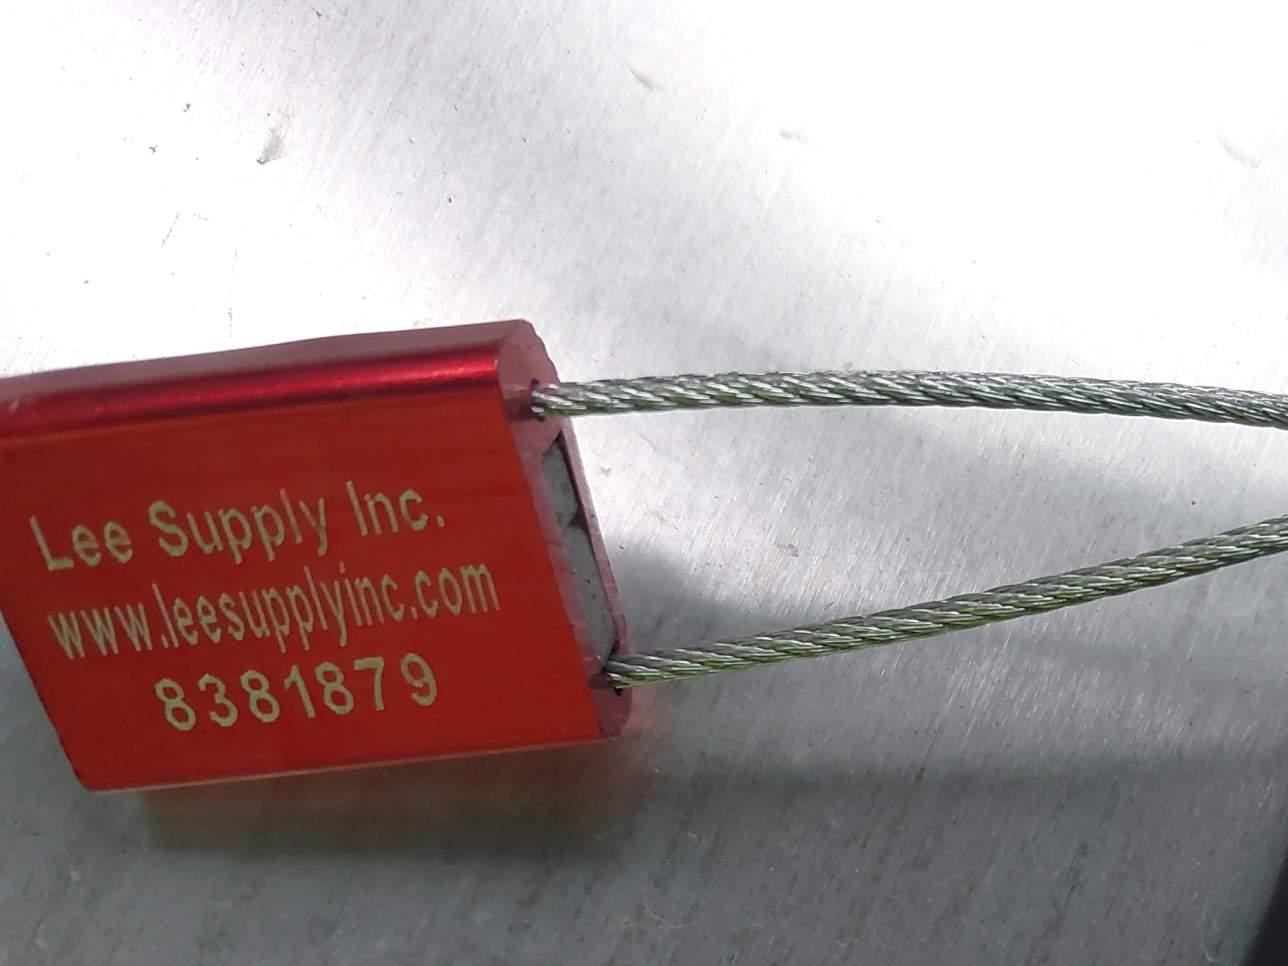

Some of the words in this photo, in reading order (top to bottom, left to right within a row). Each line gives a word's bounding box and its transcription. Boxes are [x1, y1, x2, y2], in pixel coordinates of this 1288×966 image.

[30, 516, 134, 571] Lee
[148, 488, 328, 564] Supply
[346, 480, 446, 538] Inc.
[47, 561, 501, 660] www.leesupplyinc.com
[155, 652, 438, 732] 8381879
